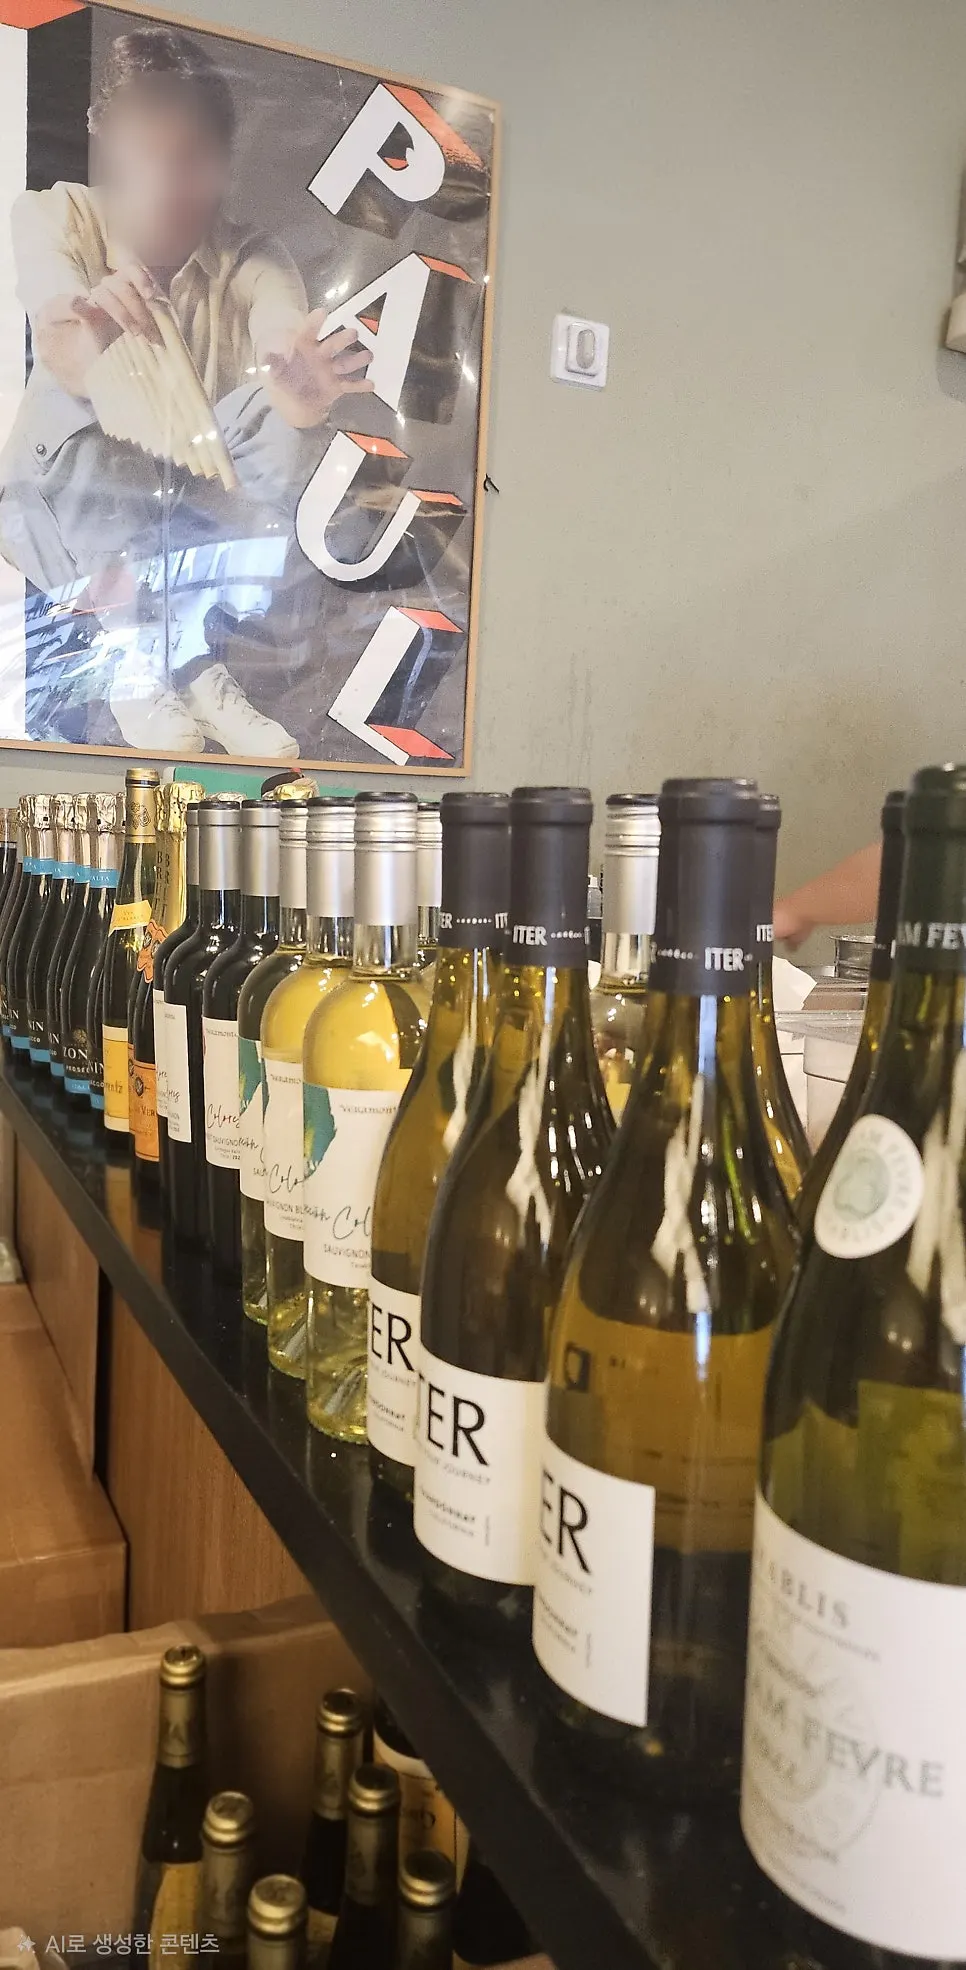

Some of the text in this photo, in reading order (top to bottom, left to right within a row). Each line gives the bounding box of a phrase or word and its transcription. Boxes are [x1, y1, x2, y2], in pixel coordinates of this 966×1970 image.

[294, 80, 472, 768] PAUL
[495, 912, 508, 930] IT
[512, 925, 548, 947] ITER
[704, 946, 745, 972] ITER
[420, 1374, 489, 1467] ER
[803, 1713, 945, 1798] FEVRE
